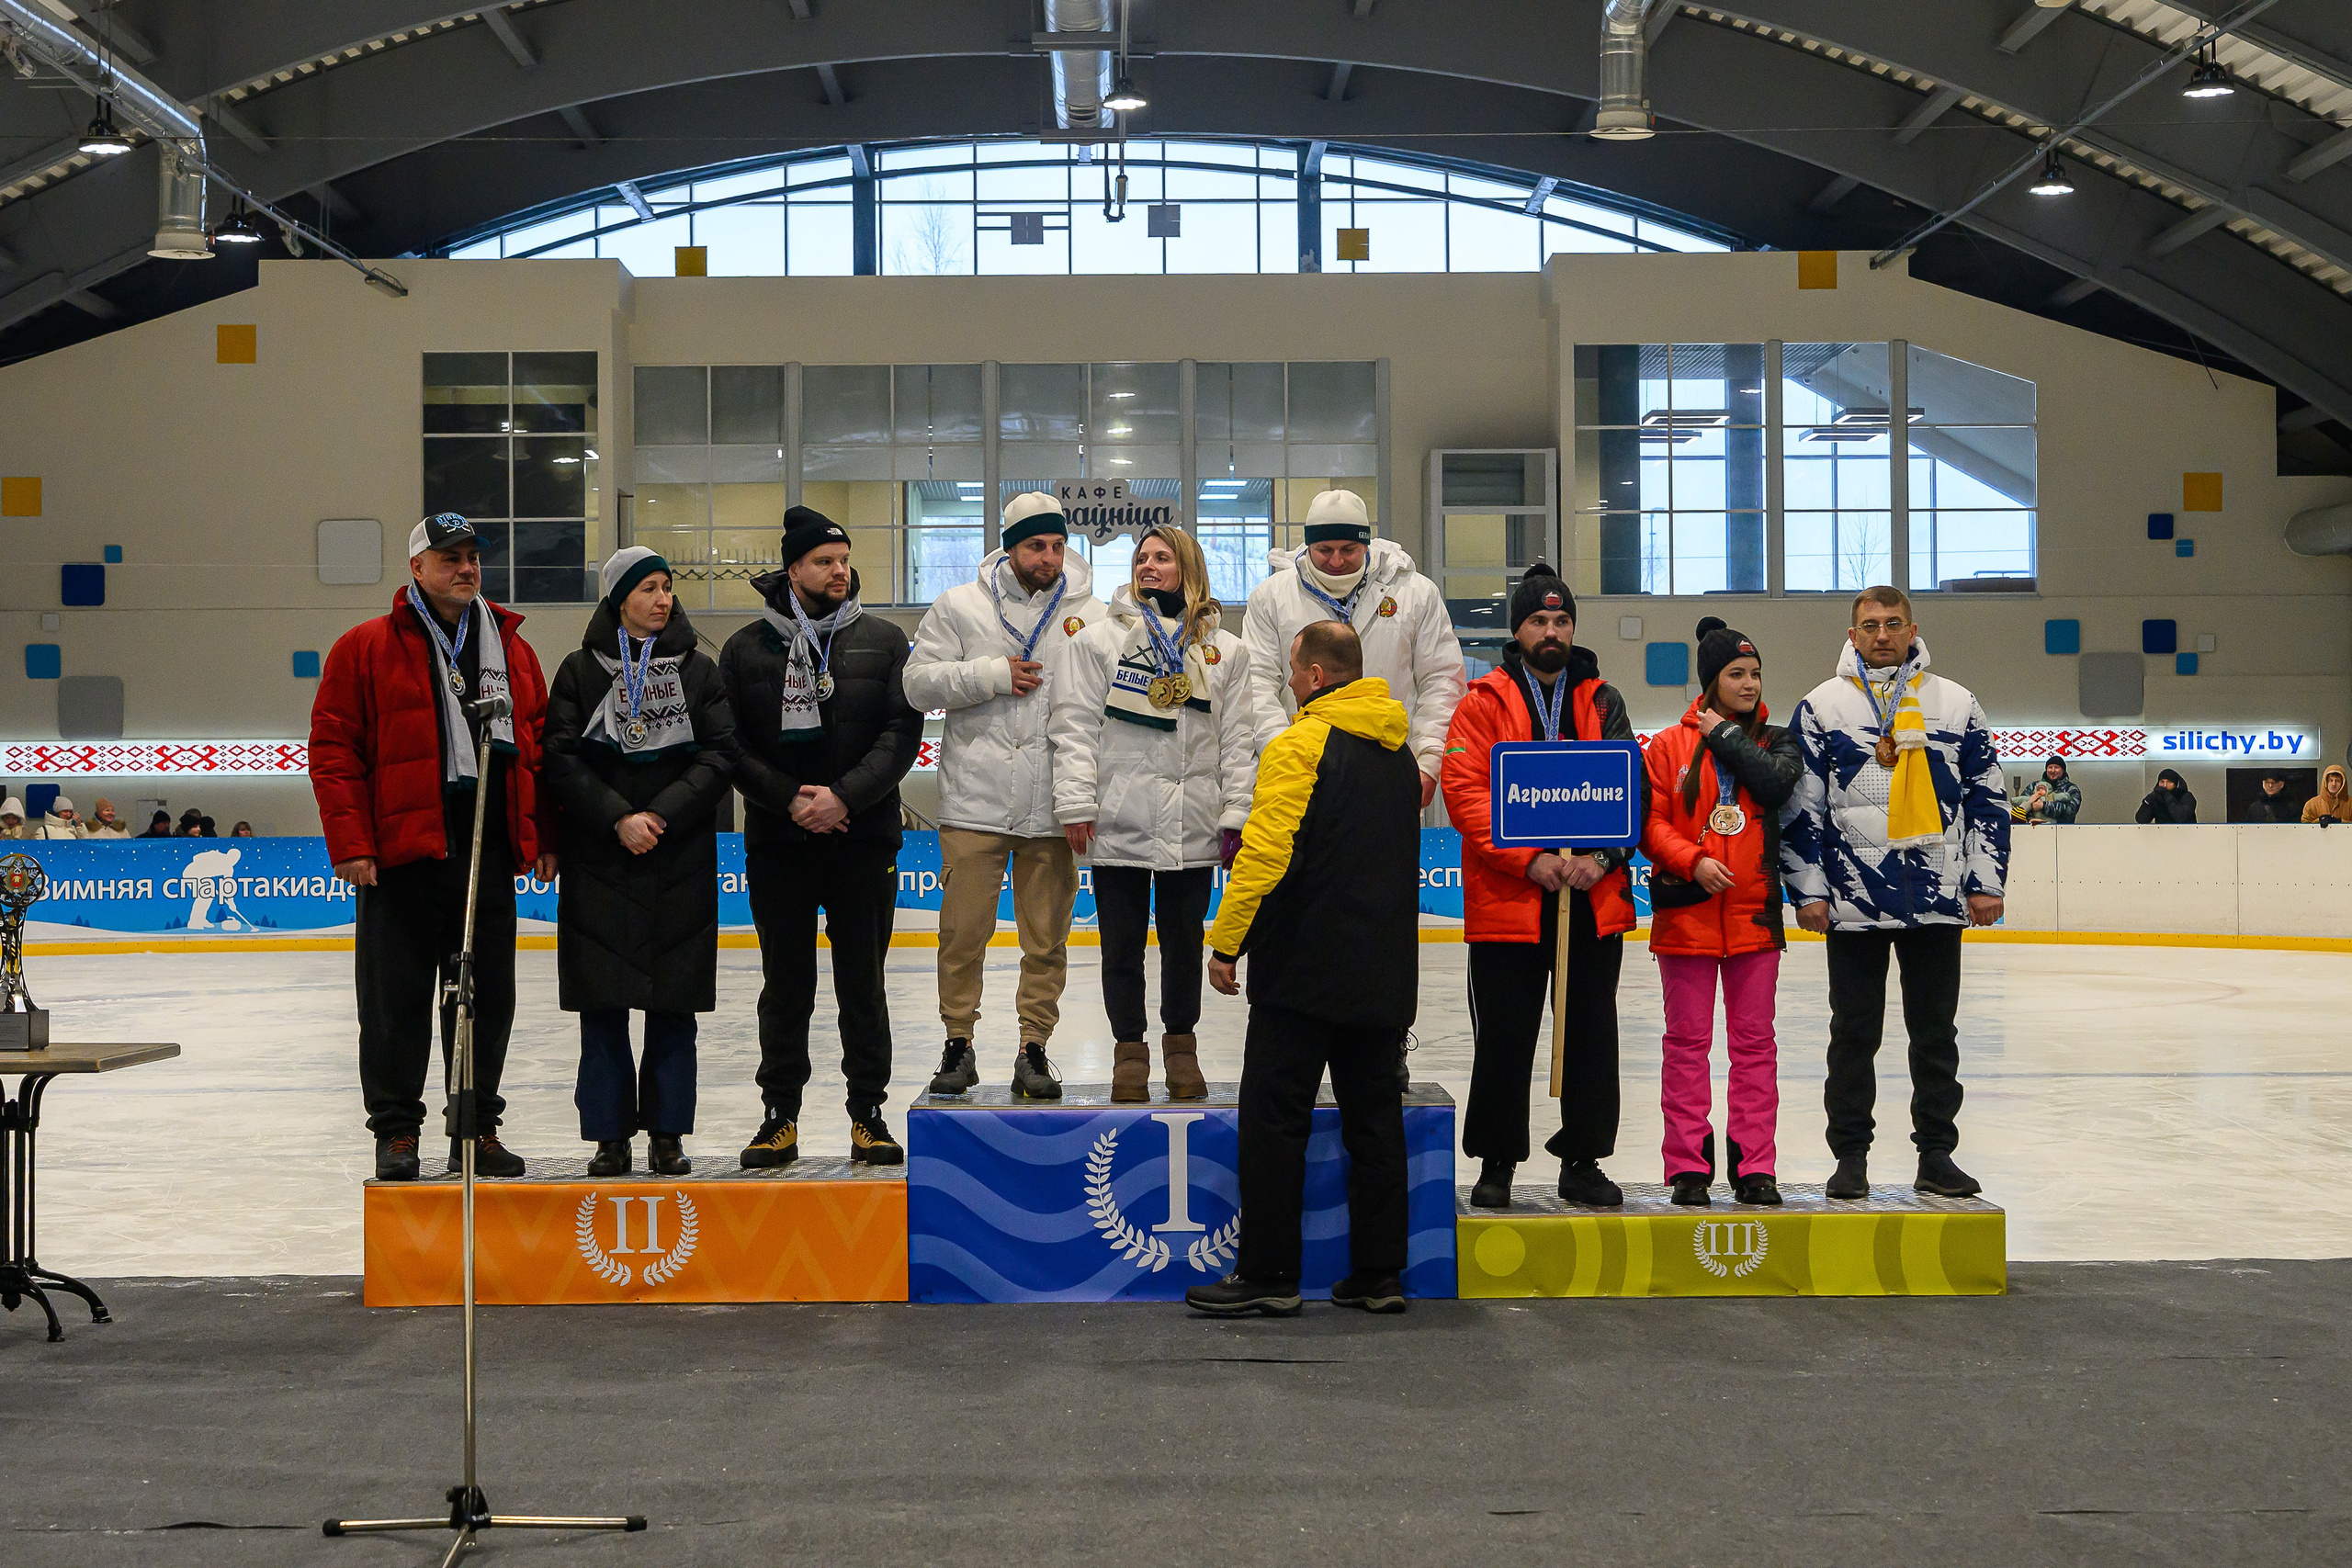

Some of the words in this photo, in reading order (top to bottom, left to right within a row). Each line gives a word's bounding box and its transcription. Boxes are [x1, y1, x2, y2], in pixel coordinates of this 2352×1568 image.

[1061, 486, 1122, 500] КАФЕ
[1116, 669, 1148, 687] БЕЛЫЕ
[2163, 730, 2304, 754] silichy.by
[1507, 781, 1624, 809] Агрохолдинг
[607, 1196, 666, 1255] II
[1708, 1223, 1755, 1257] III
